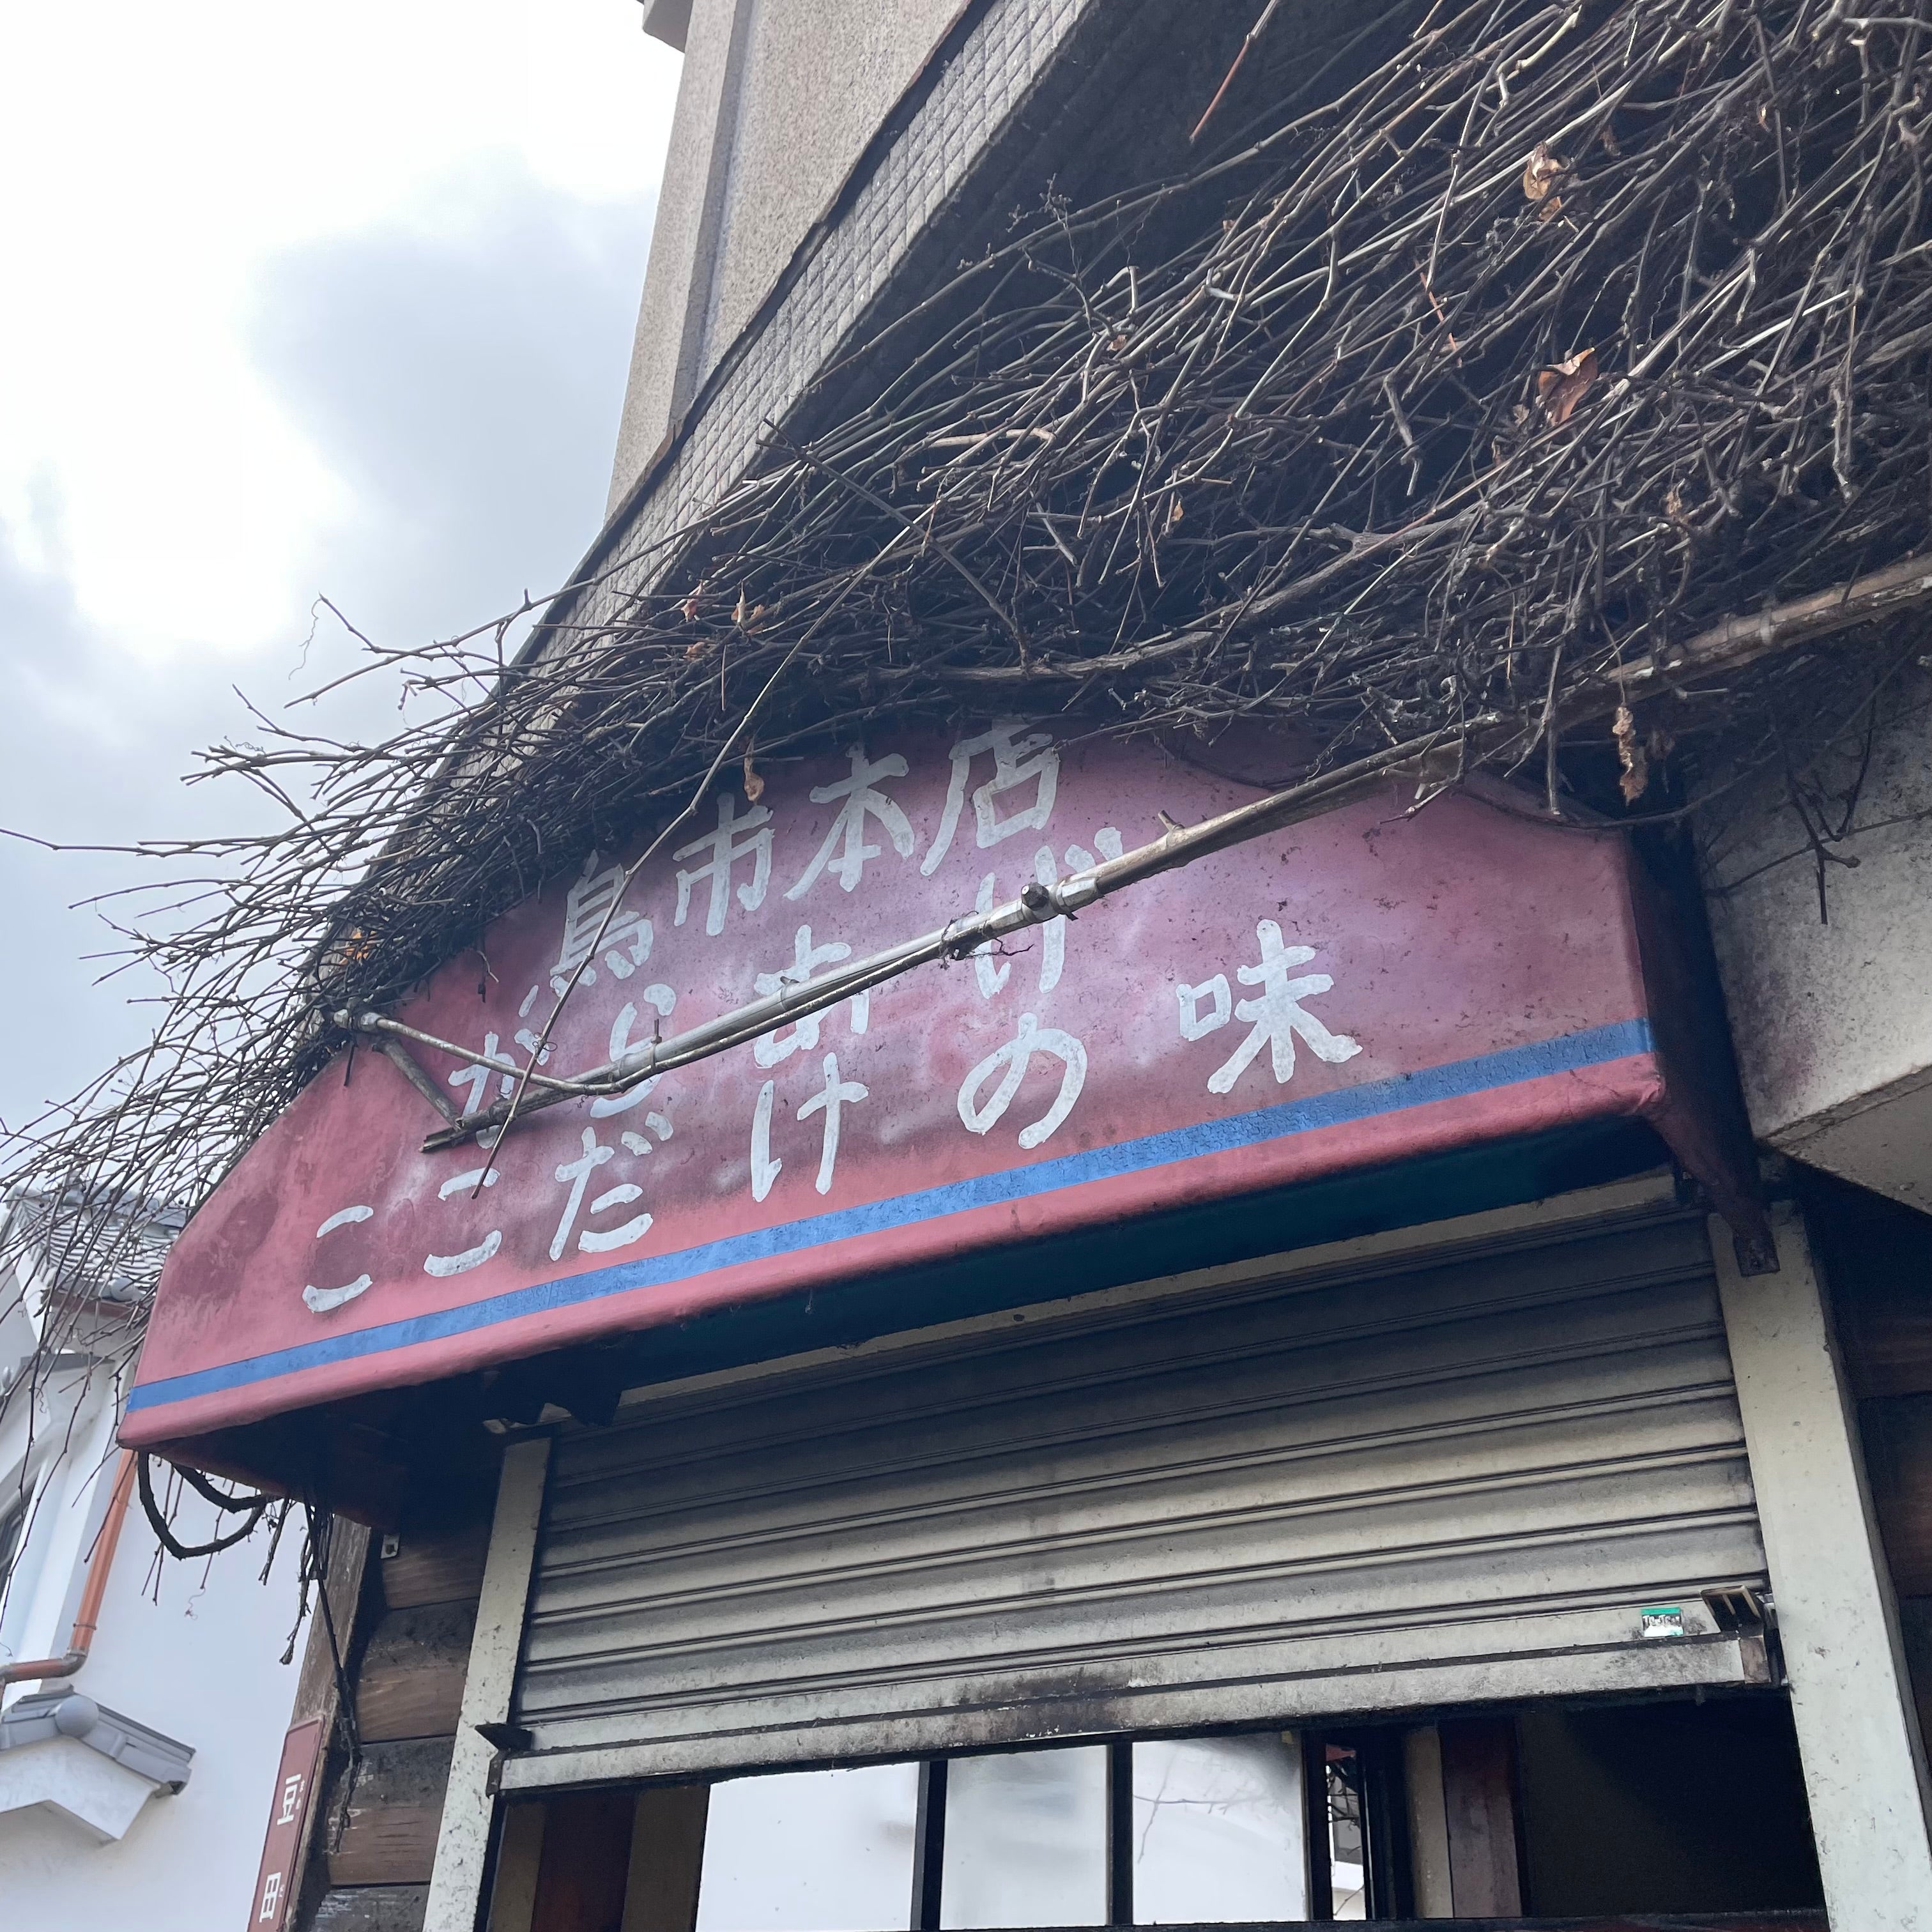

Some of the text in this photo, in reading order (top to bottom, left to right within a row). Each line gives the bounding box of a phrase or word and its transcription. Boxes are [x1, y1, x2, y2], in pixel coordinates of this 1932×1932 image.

[519, 718, 1059, 1017] 鳥市本店
[302, 919, 1363, 1314] ここだけの味
